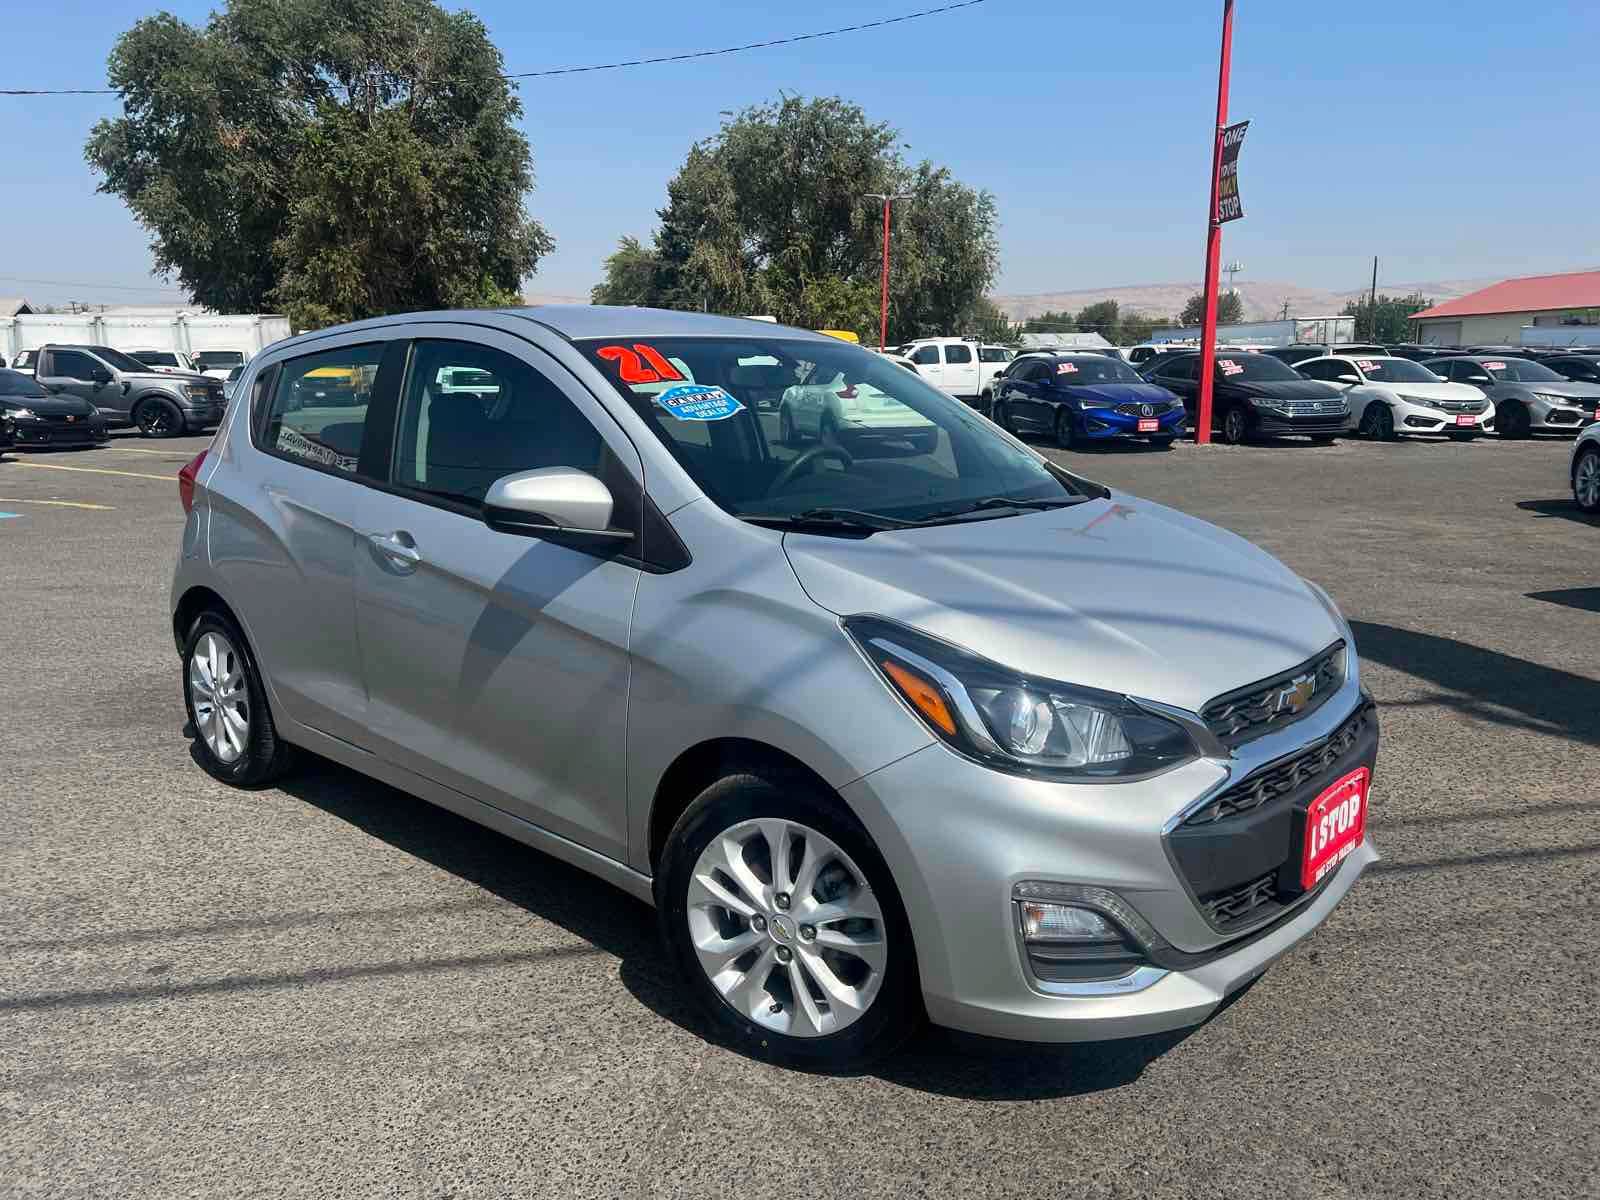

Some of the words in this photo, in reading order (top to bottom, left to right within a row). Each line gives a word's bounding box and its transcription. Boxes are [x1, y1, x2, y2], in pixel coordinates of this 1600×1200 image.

[1224, 126, 1247, 147] ONE
[1219, 196, 1239, 219] STOP
[596, 344, 684, 384] 21
[666, 391, 723, 407] CARFAX
[680, 400, 729, 414] ADVANTAGE
[695, 407, 729, 418] DEALER
[1319, 794, 1361, 849] STOP
